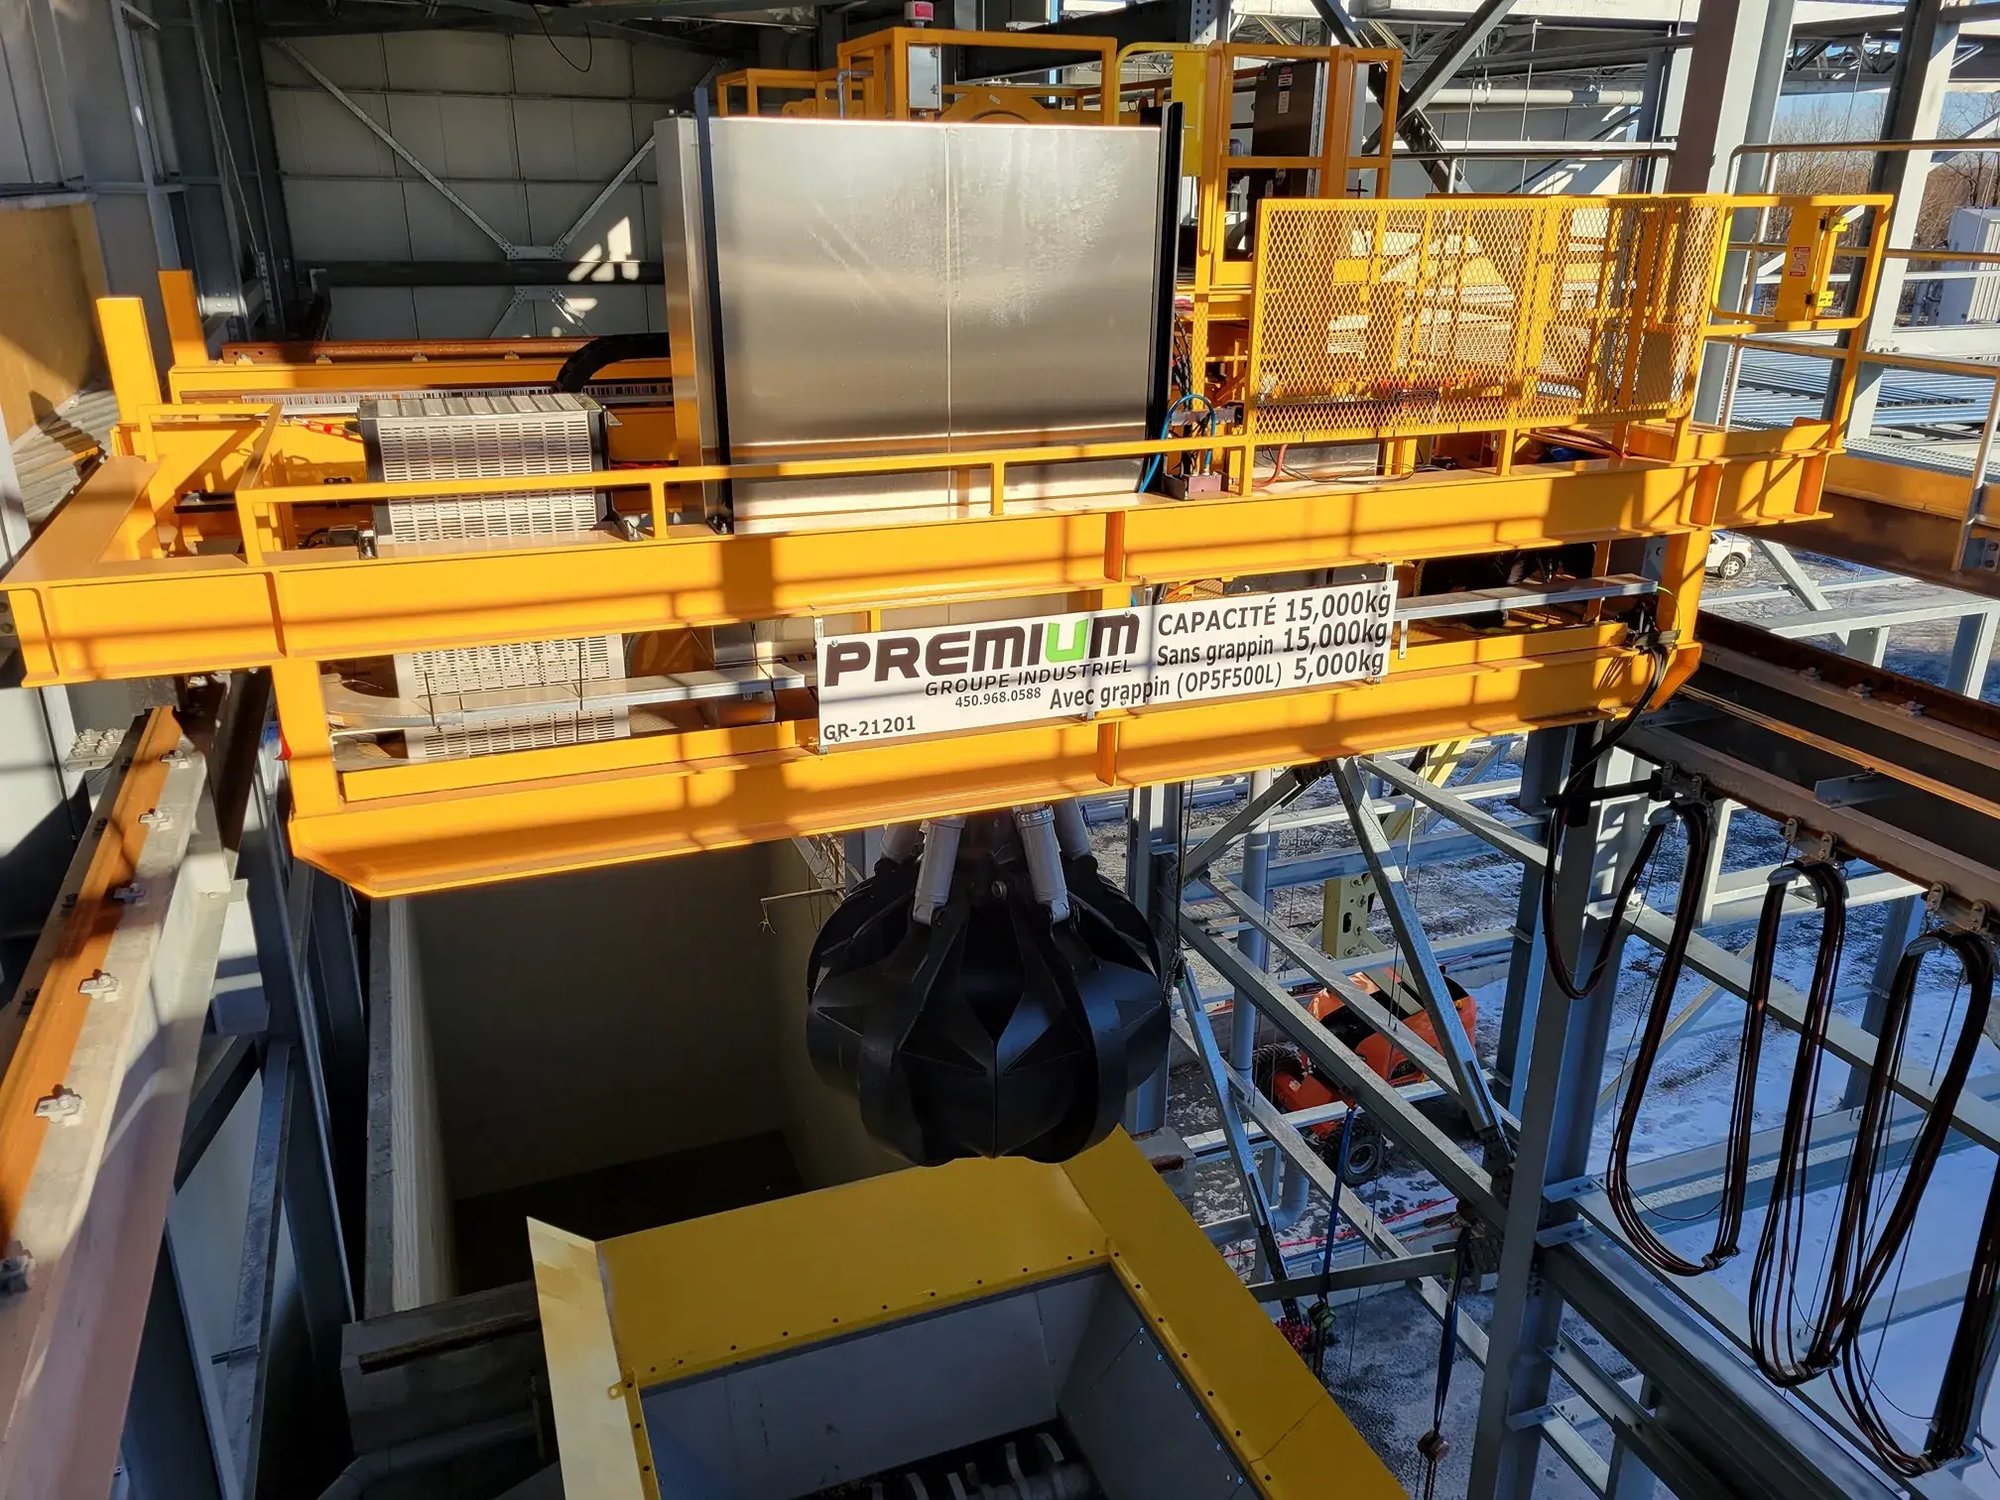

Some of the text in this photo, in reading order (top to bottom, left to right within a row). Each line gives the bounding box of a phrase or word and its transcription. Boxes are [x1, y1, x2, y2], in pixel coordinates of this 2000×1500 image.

[1158, 589, 1391, 636] CAPACITÉ 15,000kg
[824, 613, 1140, 687] PREMIUM
[1157, 618, 1388, 667] Sans grappin 15,000kg
[925, 659, 1132, 696] GROUPE INDUSTRIEL
[955, 687, 1042, 708] 450.968.0588
[1050, 649, 1384, 710] Avec grappin (OP5F500L) 5,000kg
[823, 715, 916, 741] GR-21201
